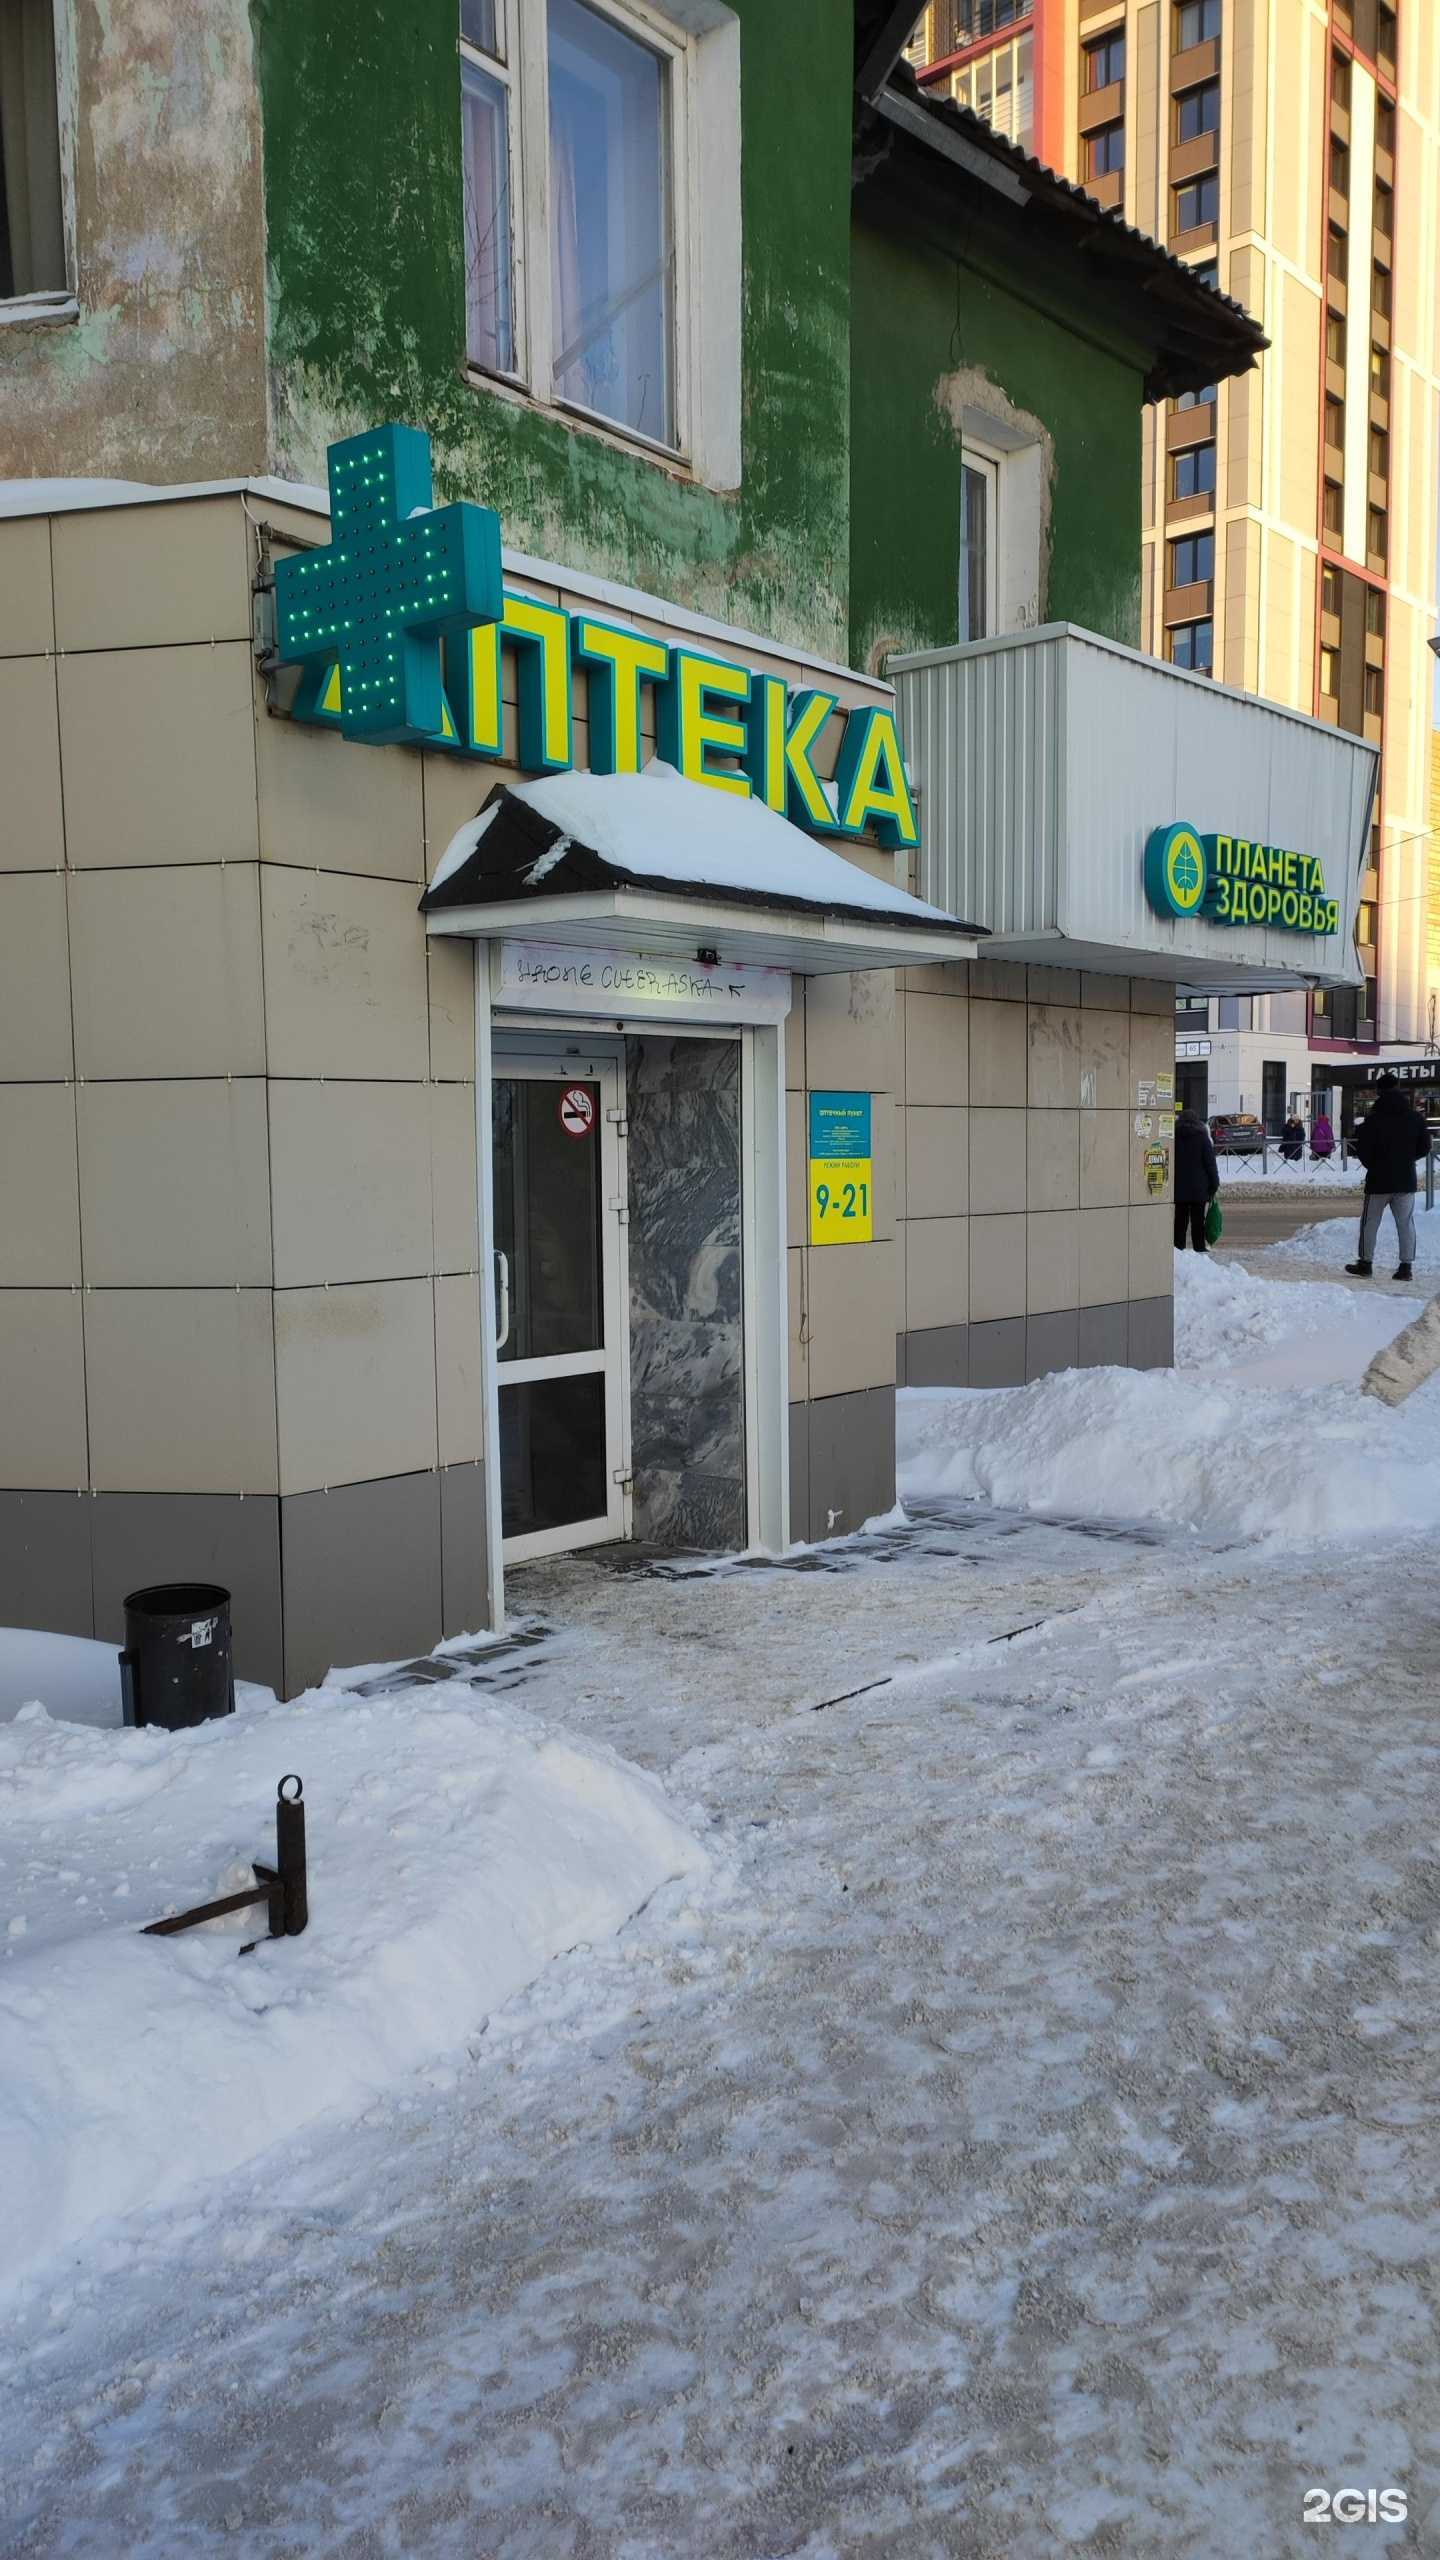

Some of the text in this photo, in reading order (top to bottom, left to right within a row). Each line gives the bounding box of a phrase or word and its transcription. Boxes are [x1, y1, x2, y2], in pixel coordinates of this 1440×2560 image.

[318, 592, 921, 849] ПТЕКА
[1216, 835, 1326, 893] ПЛАНЕТА
[1216, 879, 1339, 933] ЗДОРОВЬЯ
[816, 1183, 868, 1218] 9-21
